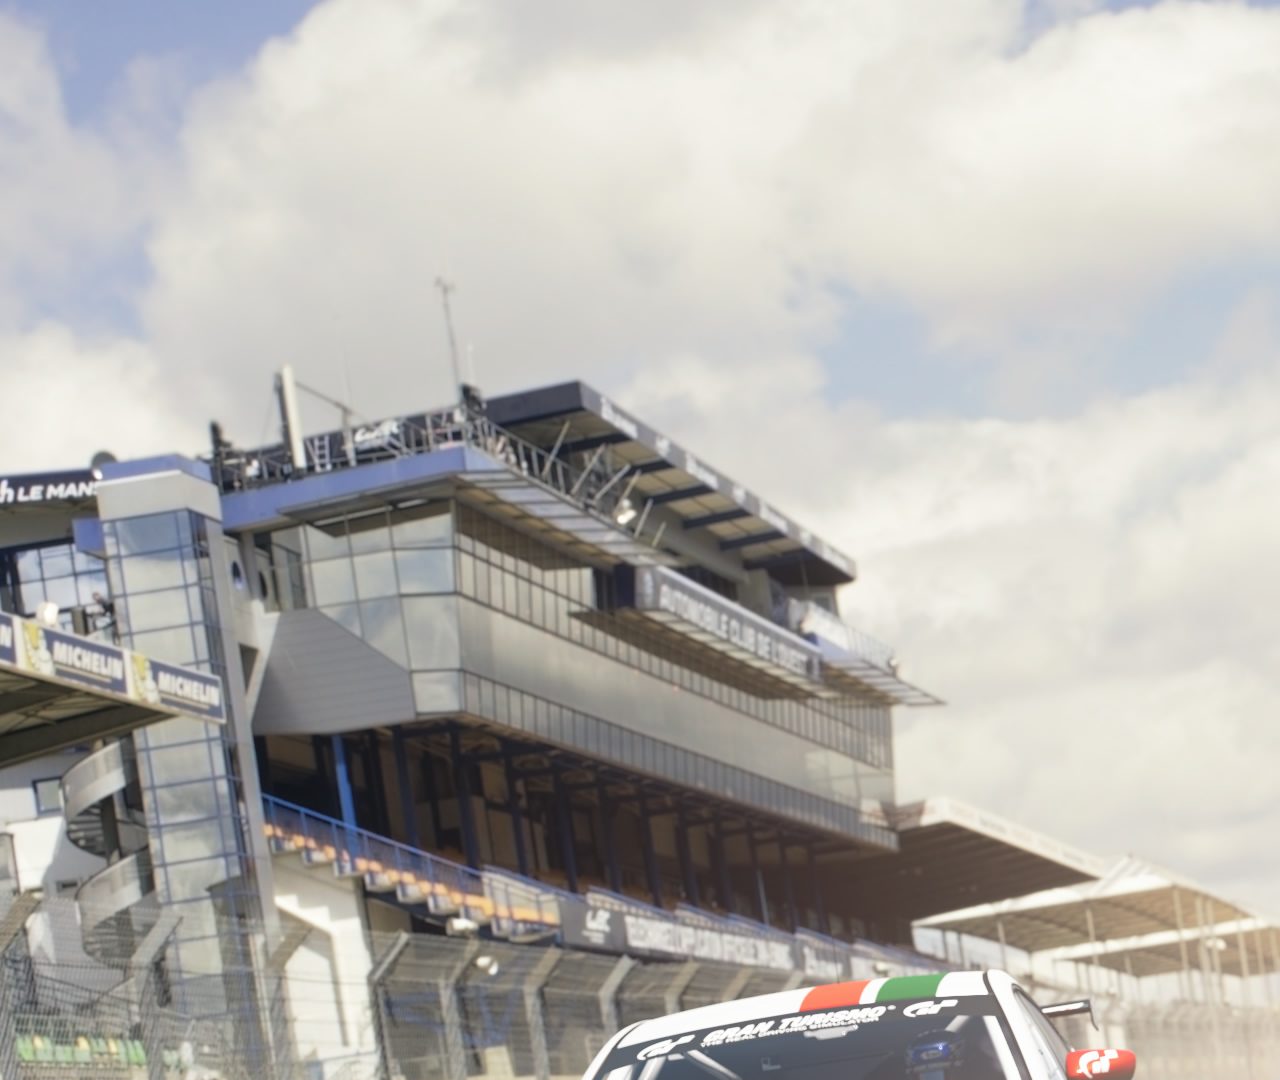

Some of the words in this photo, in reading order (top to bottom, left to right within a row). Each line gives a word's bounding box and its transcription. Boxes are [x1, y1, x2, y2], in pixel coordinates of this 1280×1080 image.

[17, 485, 43, 501] LE
[53, 641, 124, 680] MICHELIN
[158, 671, 221, 707] MICHELIN
[703, 1021, 775, 1043] GRAN
[780, 1005, 887, 1029] TURISMO
